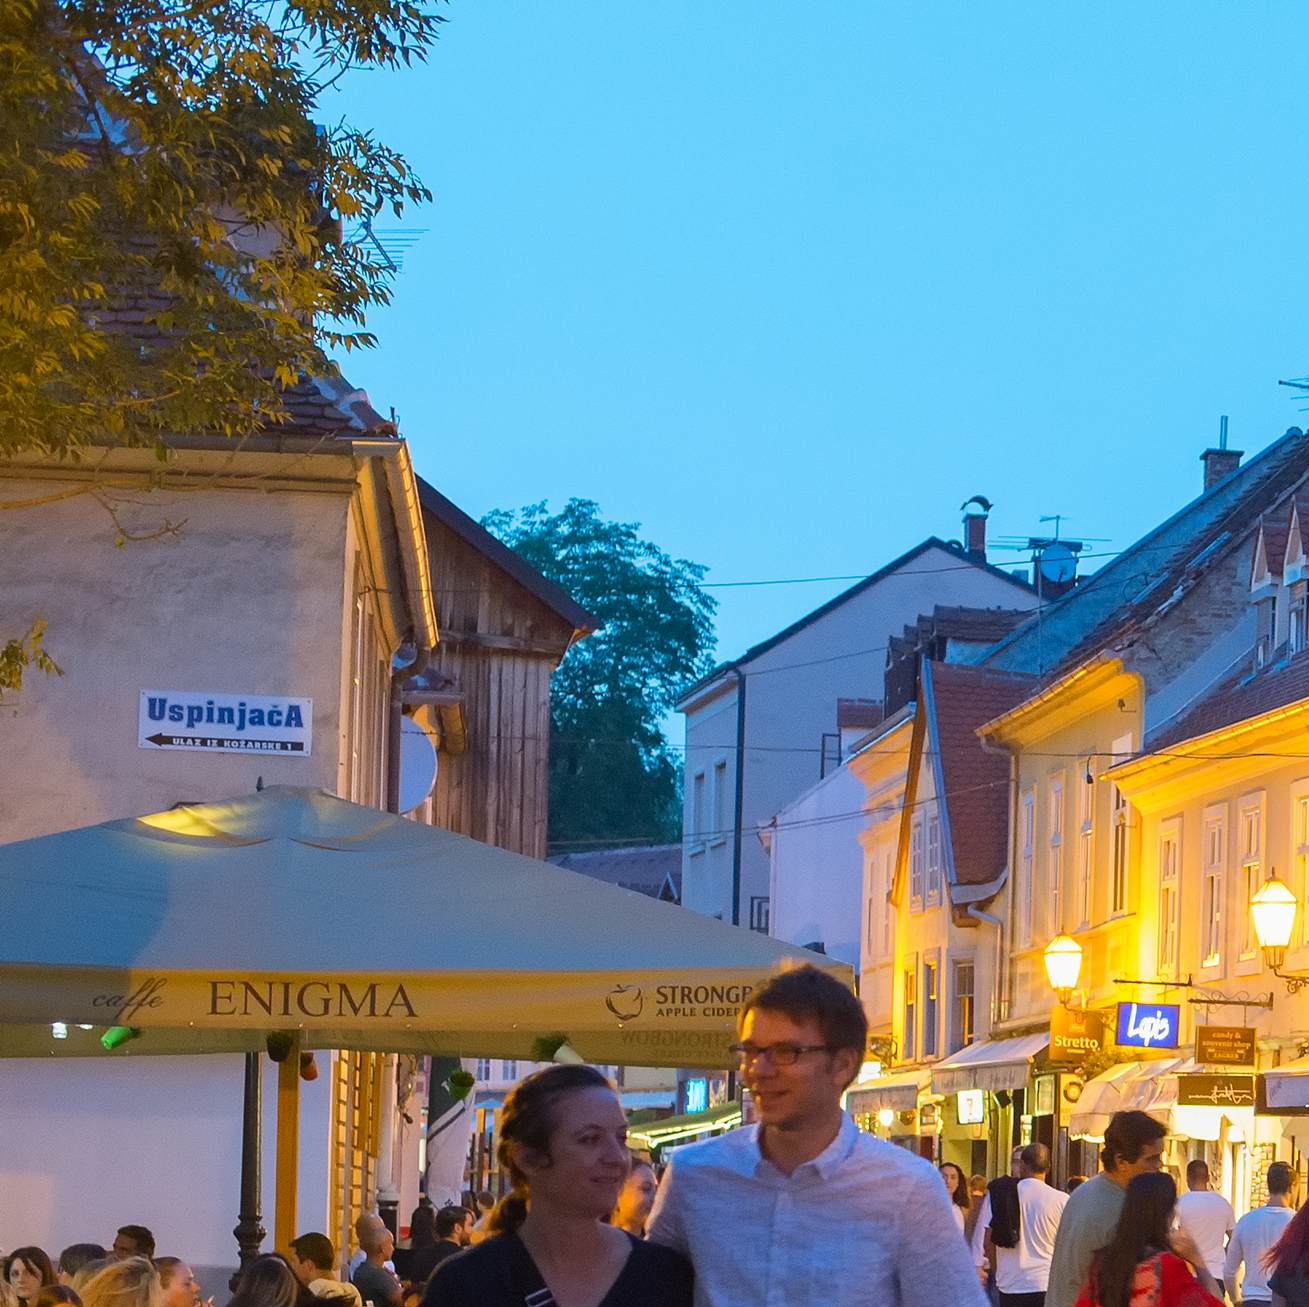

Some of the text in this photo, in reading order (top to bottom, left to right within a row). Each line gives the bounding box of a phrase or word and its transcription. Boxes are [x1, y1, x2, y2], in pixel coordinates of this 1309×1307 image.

[172, 737, 201, 746] ULAZ
[207, 738, 218, 747] IZ
[224, 738, 281, 750] KOŽARSKE
[92, 978, 418, 1020] caffe ENIGMA
[656, 1007, 696, 1017] APPLE
